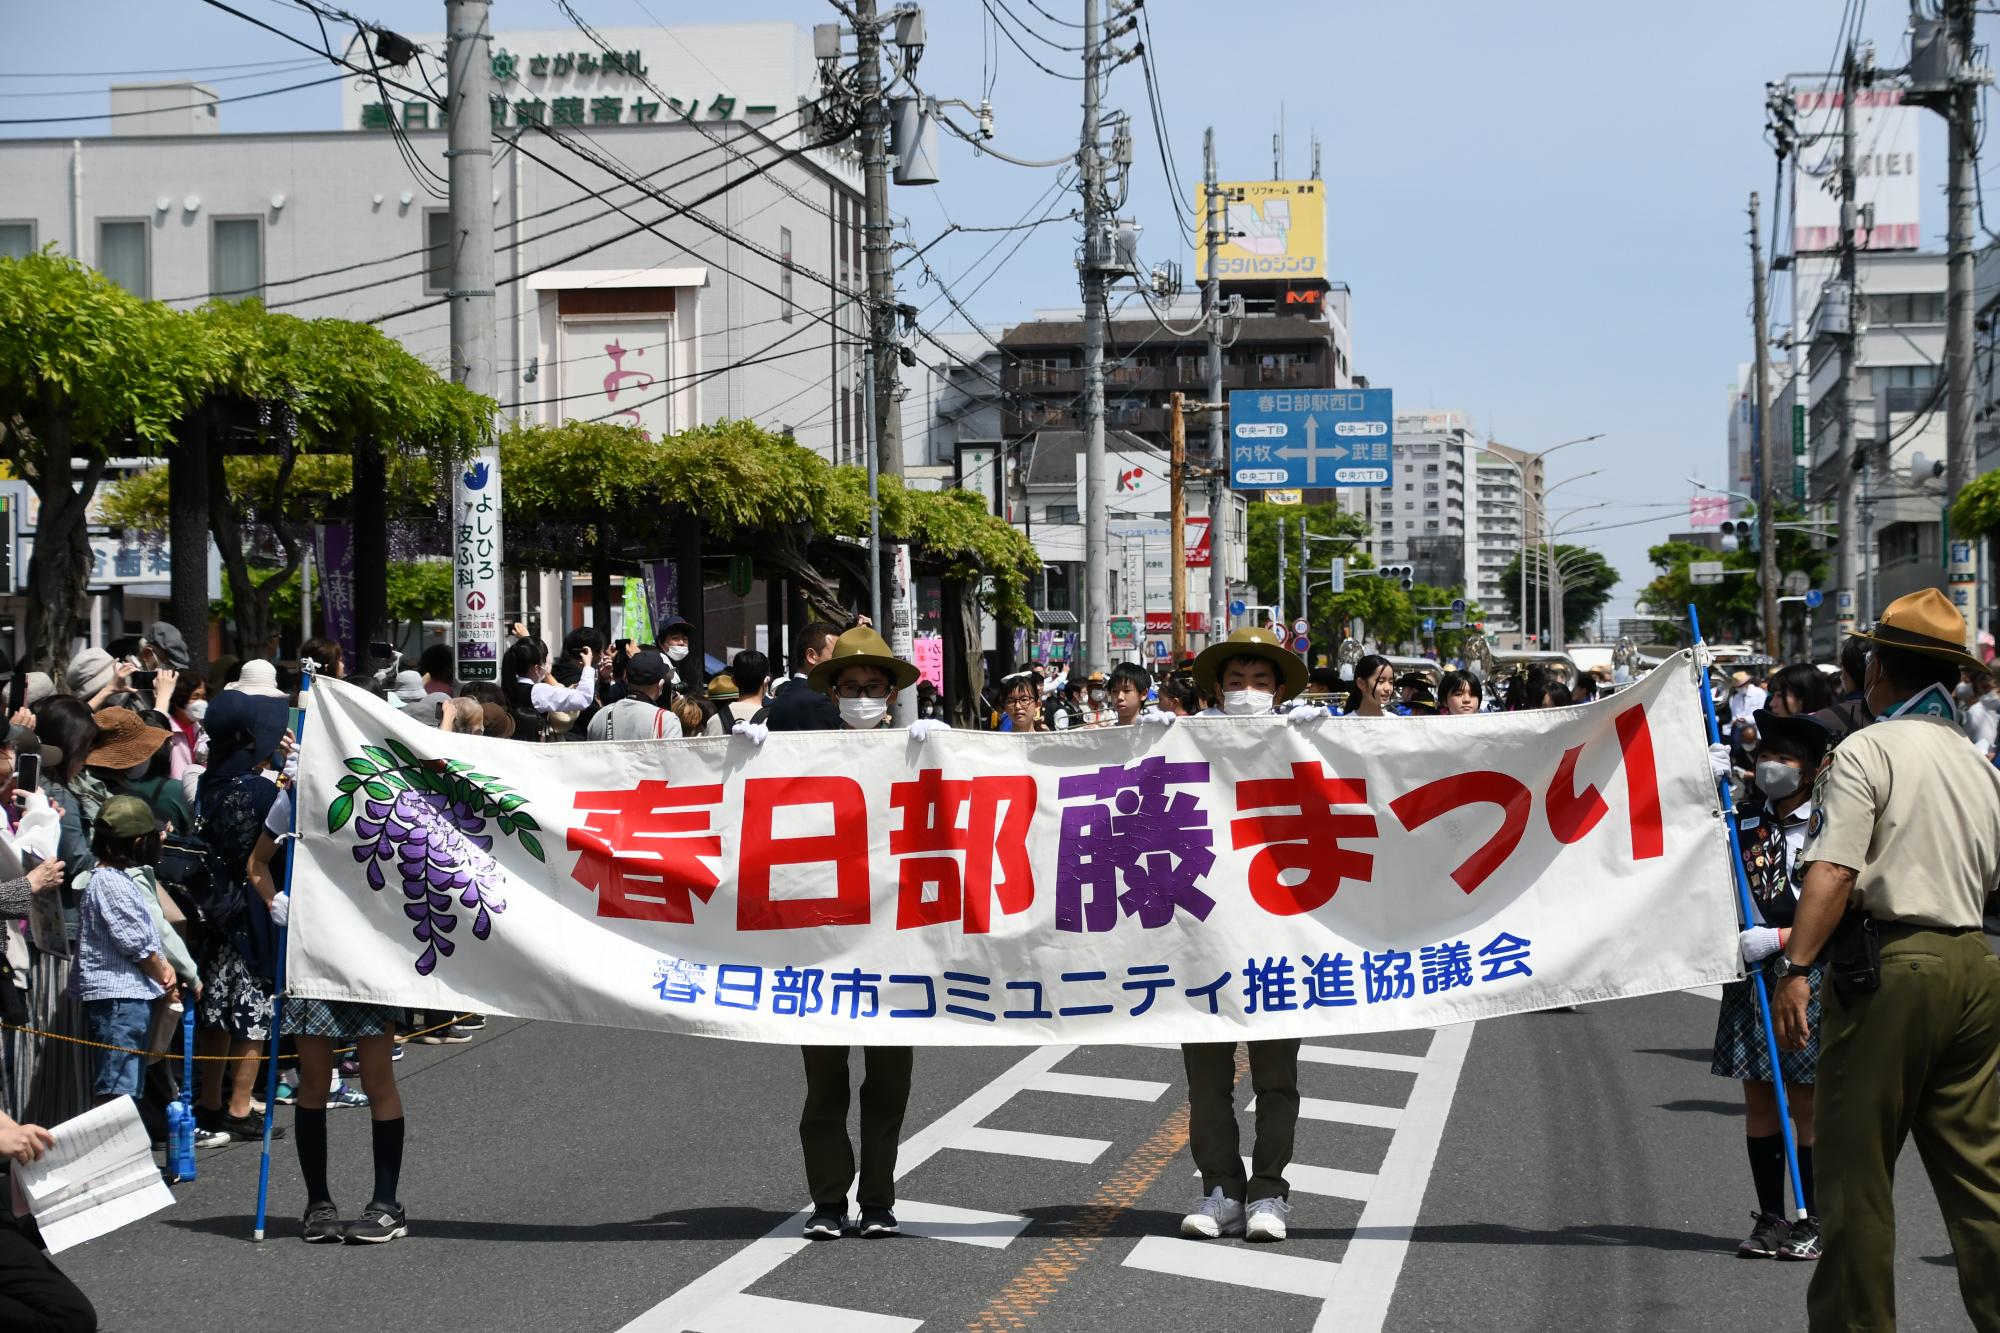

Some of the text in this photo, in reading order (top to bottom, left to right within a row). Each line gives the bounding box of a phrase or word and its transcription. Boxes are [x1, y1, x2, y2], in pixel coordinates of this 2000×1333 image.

[1257, 393, 1364, 412] 春日部駅西口
[1238, 425, 1285, 435] 中央一丁目
[1338, 424, 1384, 433] 中央一丁目
[1235, 444, 1272, 462] 内牧
[1351, 443, 1389, 461] 武里
[1239, 472, 1285, 481] 中央二丁目
[1338, 470, 1384, 480] 中央六丁目
[475, 494, 494, 580] よしひろ
[457, 523, 475, 589] 皮ふ科
[477, 667, 493, 675] 2-17
[566, 703, 1664, 934] 春日部藤まつり
[652, 931, 1533, 1022] 春日部市コミュニティ推進協議会
